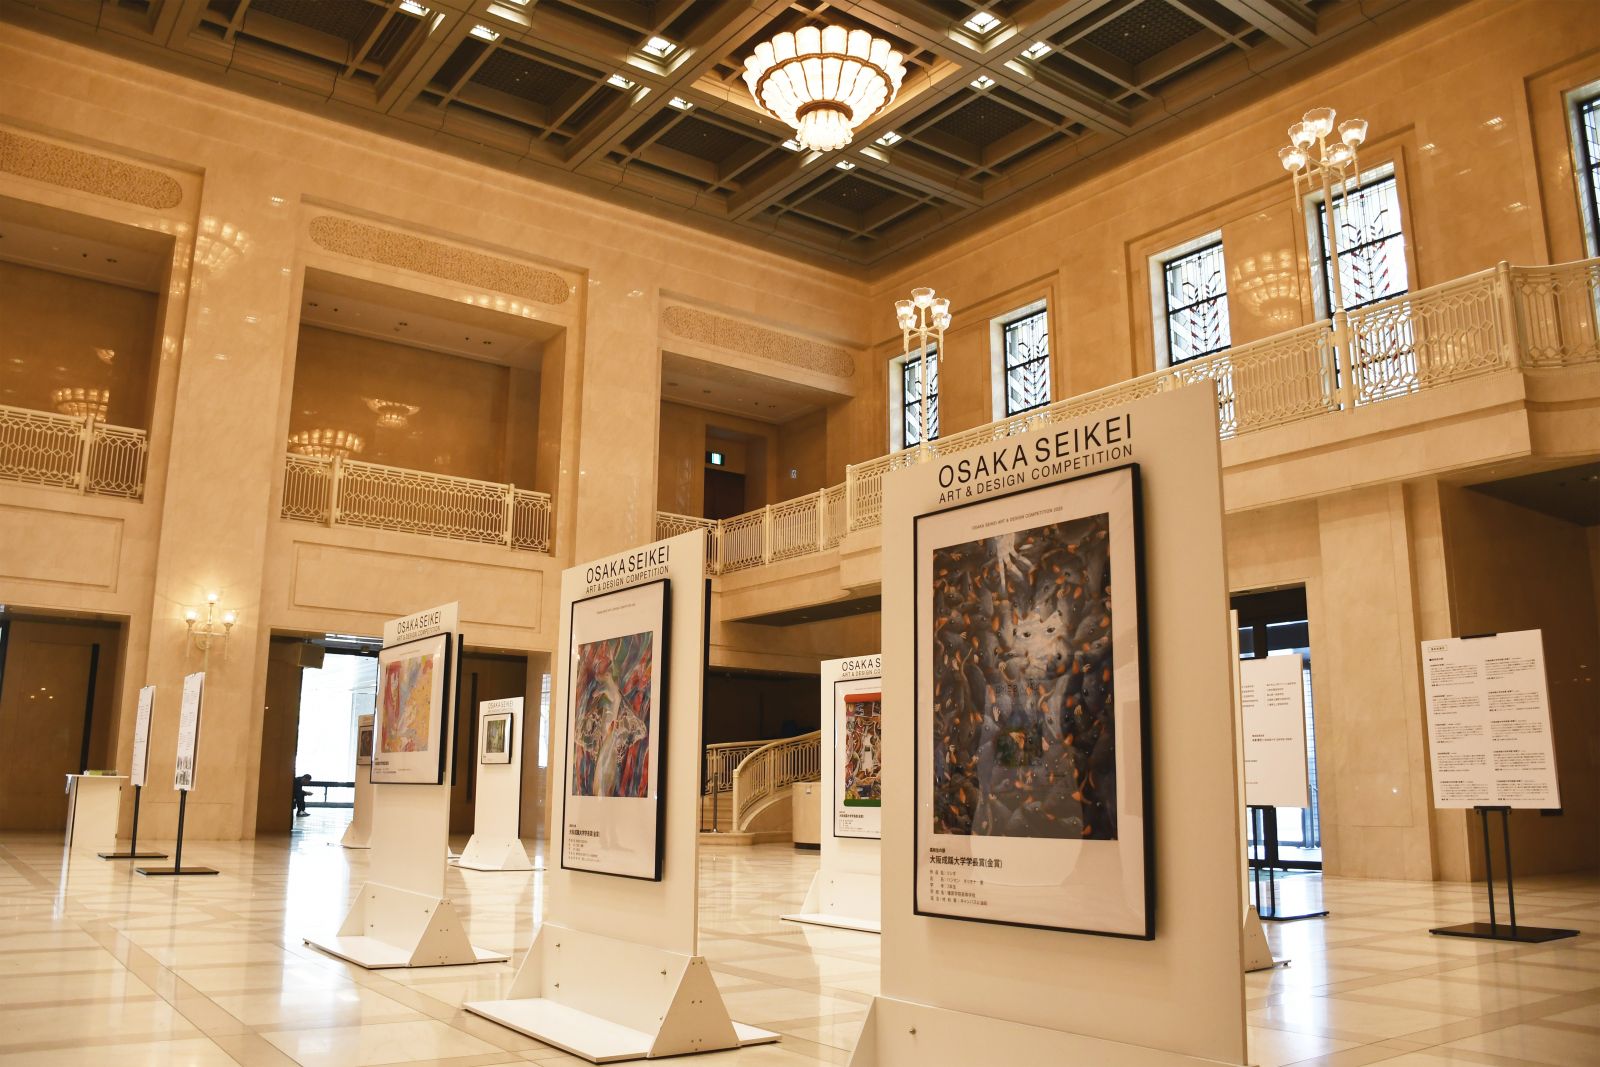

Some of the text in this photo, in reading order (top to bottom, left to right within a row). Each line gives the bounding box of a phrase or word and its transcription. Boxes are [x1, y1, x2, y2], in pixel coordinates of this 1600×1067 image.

[938, 414, 1132, 488] OSAKA SEIKEI
[938, 444, 1132, 504] ART & DESIGN COMPETITION
[586, 545, 670, 584] OSAKA SEIKEI
[586, 584, 596, 594] ART
[603, 578, 624, 590] DESIGN
[626, 565, 669, 583] COMPETITION
[397, 611, 441, 634] OSAKA SEIKEI
[842, 658, 873, 671] OSAKA
